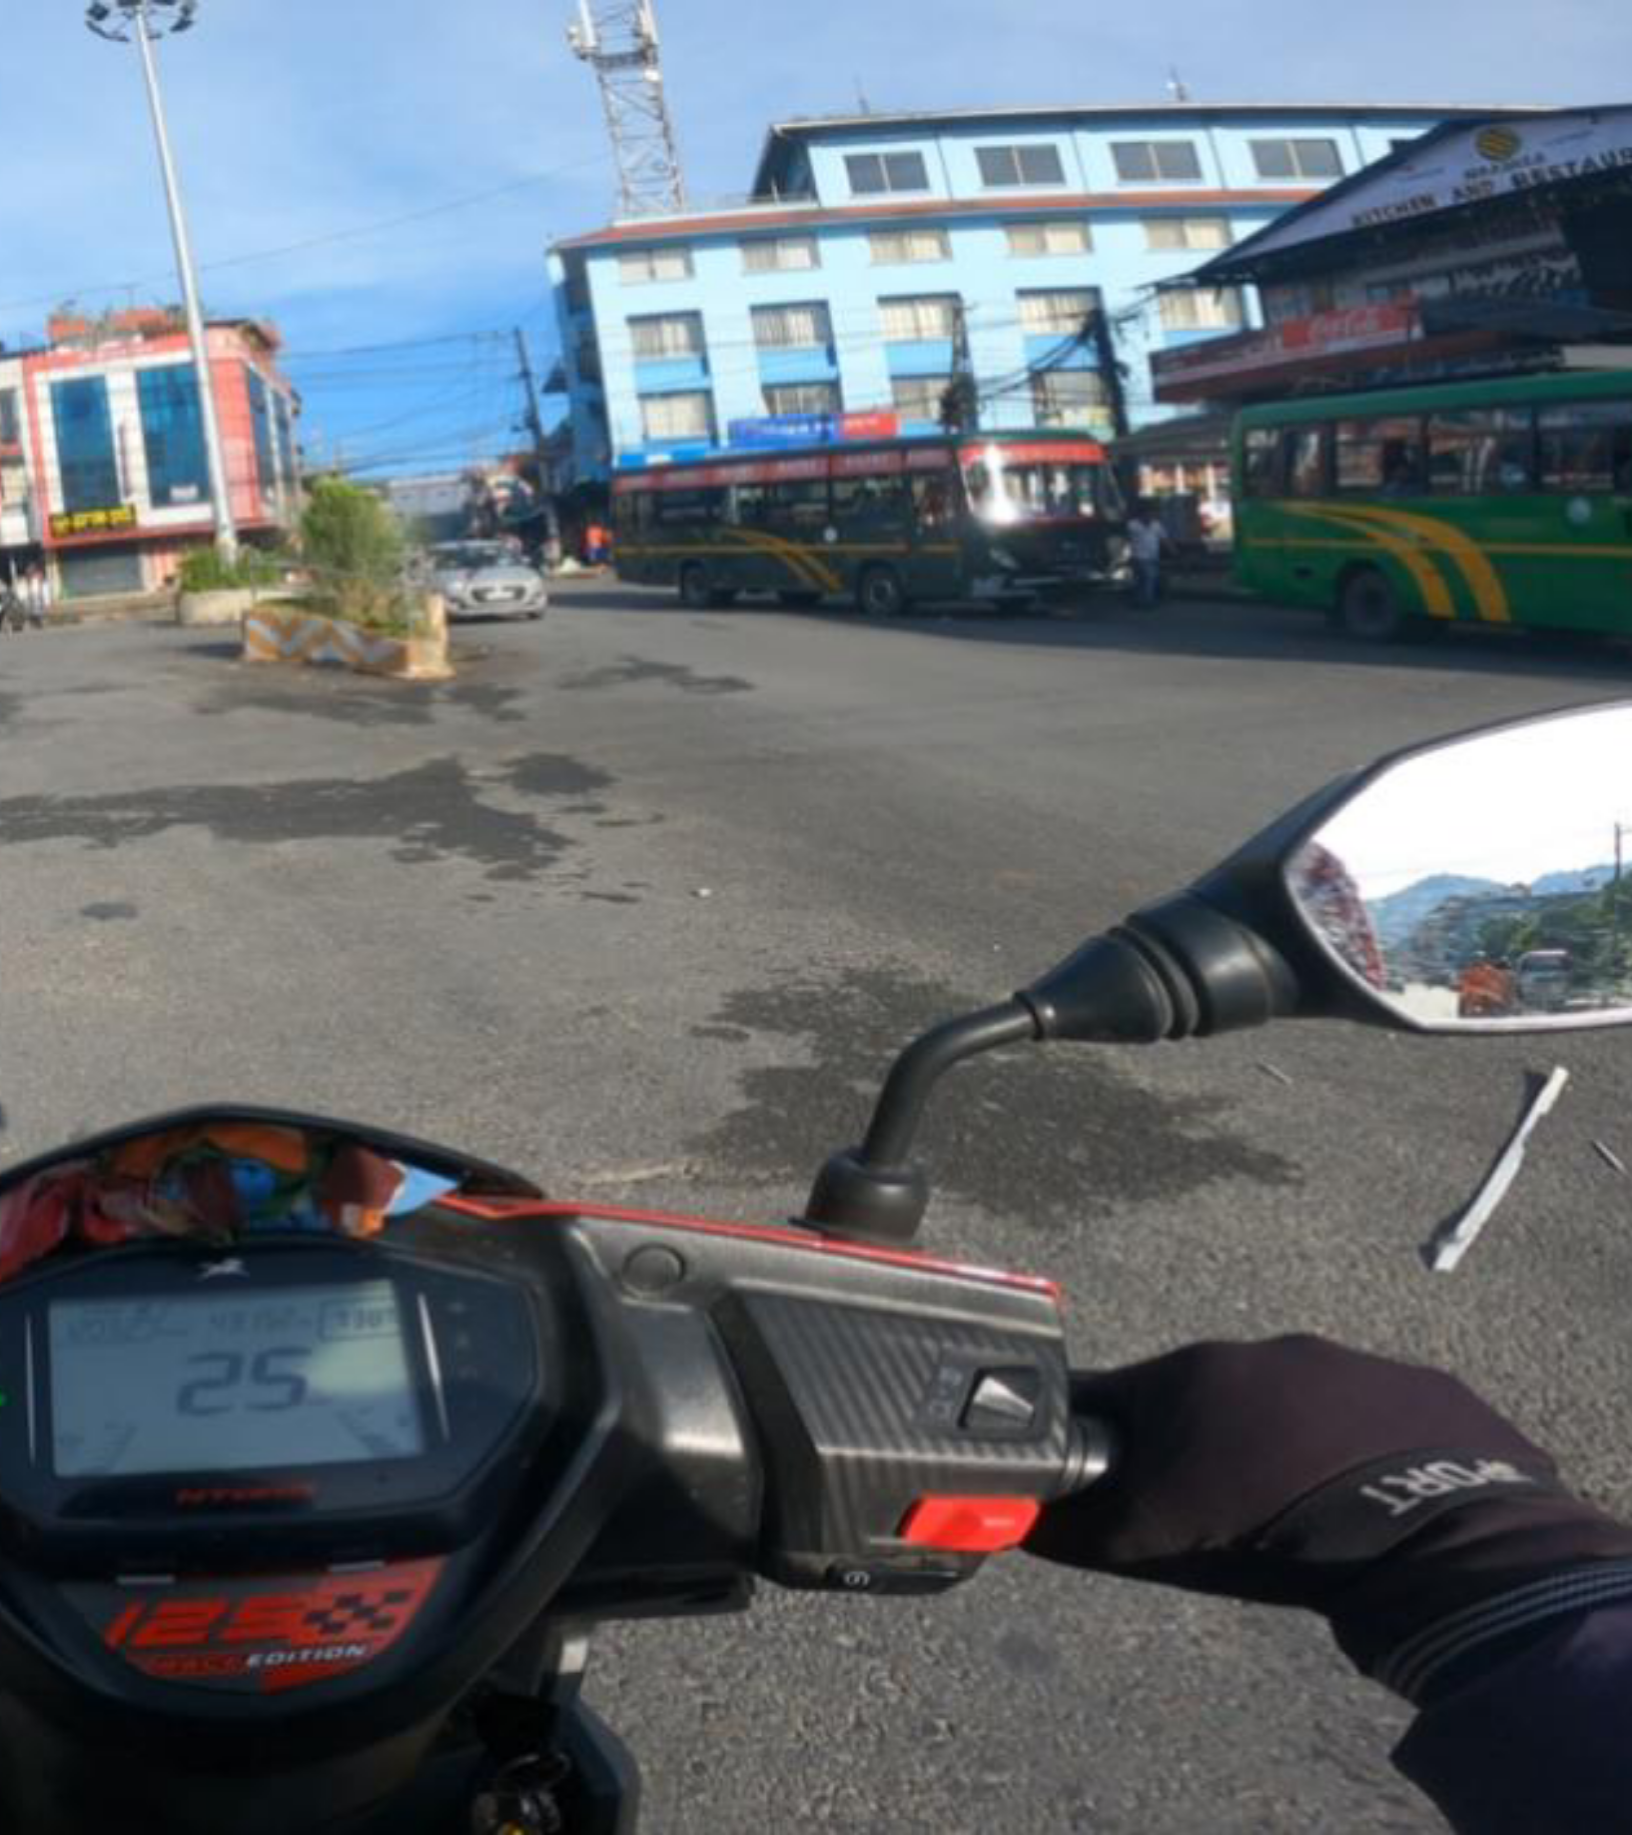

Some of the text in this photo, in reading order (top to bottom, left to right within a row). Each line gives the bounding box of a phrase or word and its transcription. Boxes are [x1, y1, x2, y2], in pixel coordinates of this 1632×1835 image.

[177, 1346, 313, 1417] 25
[104, 1593, 310, 1653] 125
[246, 1643, 368, 1669] EDITION
